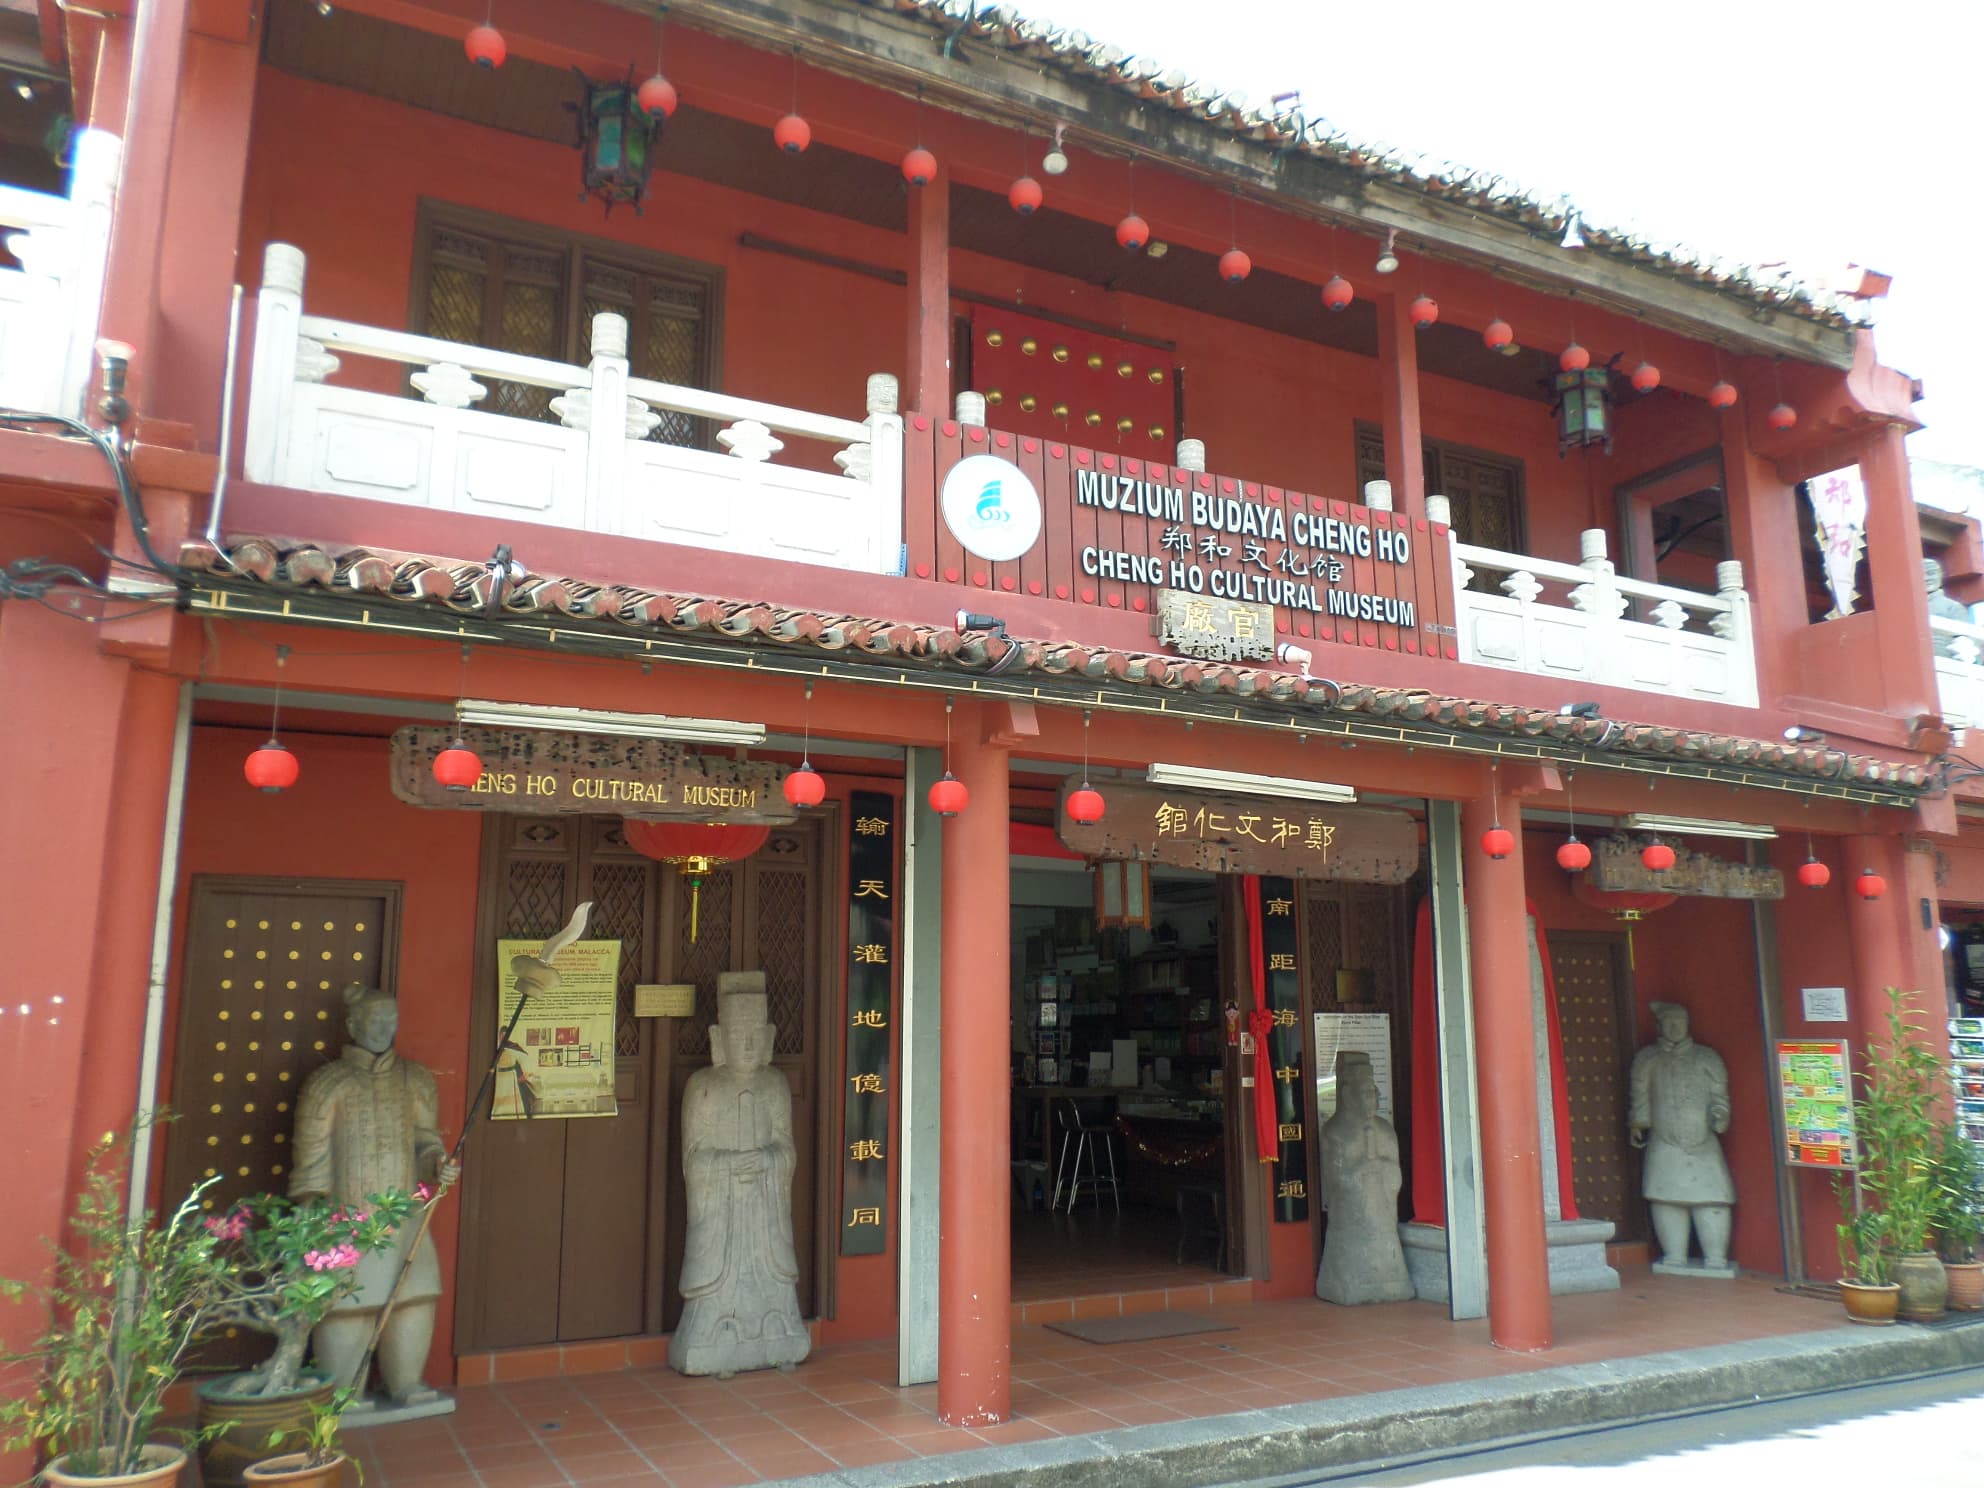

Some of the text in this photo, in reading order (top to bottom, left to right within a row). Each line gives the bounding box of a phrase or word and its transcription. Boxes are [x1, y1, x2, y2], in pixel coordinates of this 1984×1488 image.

[1077, 468, 1409, 564] MUZIUM BUDAYA CHENG HO
[1080, 547, 1414, 628] CHENG HO CULTURAL MUSEUM
[1161, 527, 1345, 583] 郑和文化馆
[471, 773, 756, 808] ENG HO CULTURAL MUSEUM
